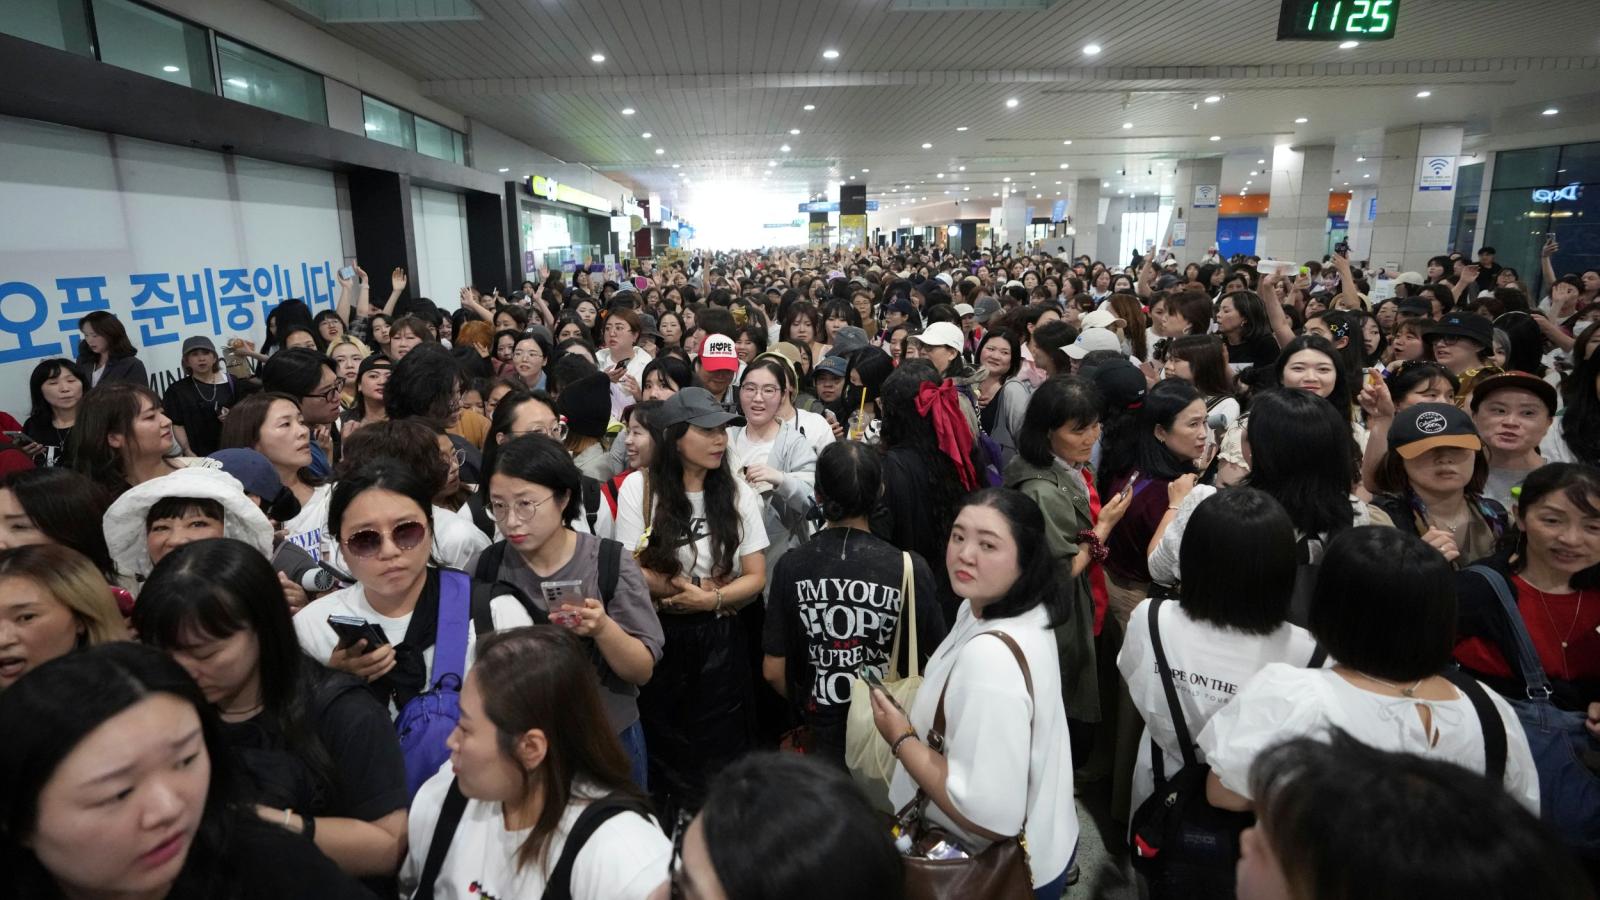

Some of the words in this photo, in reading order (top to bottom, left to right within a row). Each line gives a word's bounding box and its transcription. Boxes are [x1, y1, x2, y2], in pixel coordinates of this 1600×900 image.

[0, 276, 110, 364] 오픈
[130, 261, 335, 347] 준비중입니다
[795, 579, 829, 603] I'M
[830, 579, 901, 612] YOUR
[798, 602, 899, 645] HOPE
[808, 645, 864, 667] YU'RE
[1189, 672, 1208, 688] ON
[1210, 678, 1238, 695] THE
